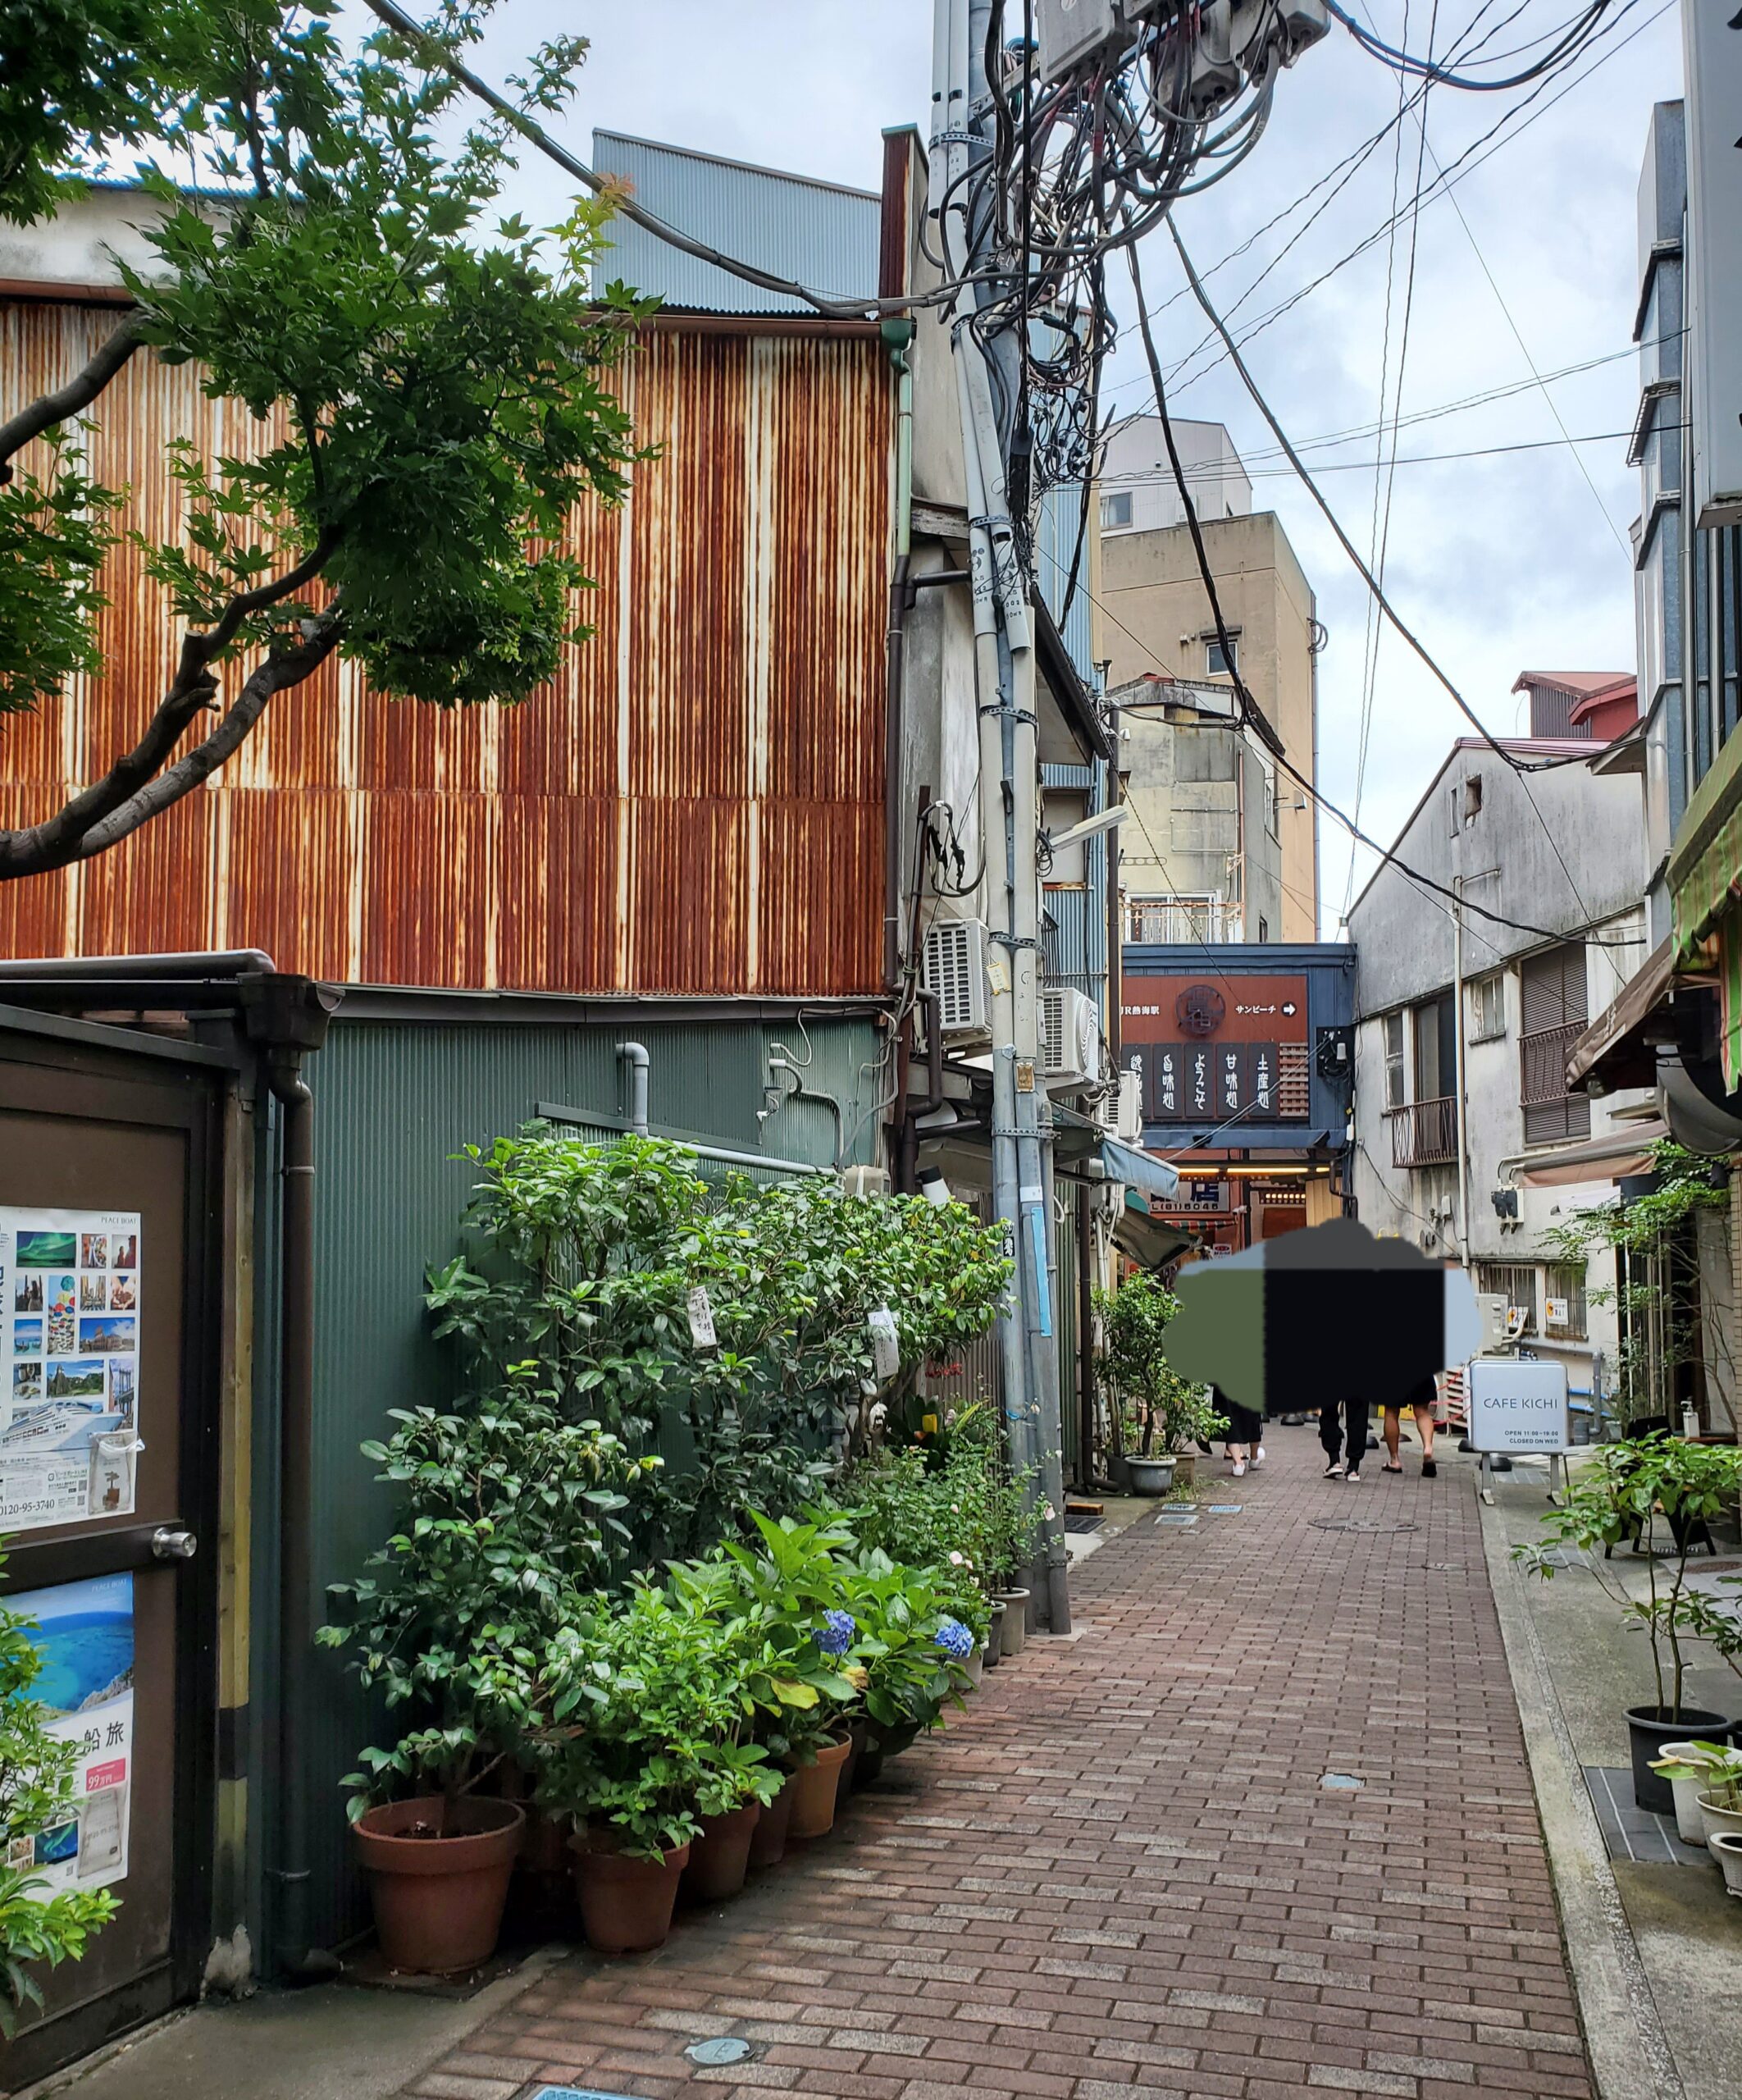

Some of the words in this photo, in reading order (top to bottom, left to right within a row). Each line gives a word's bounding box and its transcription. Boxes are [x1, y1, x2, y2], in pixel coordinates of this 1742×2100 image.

[1120, 1005, 1160, 1016] JR熱海駅
[1235, 1005, 1276, 1014] サンビーチ
[1194, 1053, 1206, 1110] ようこそ
[1225, 1053, 1238, 1109] 甘味処
[1257, 1053, 1270, 1109] 土産処
[1484, 1398, 1517, 1408] CAFE
[1522, 1398, 1557, 1409] KICHI
[88, 1774, 112, 1790] 99万円
